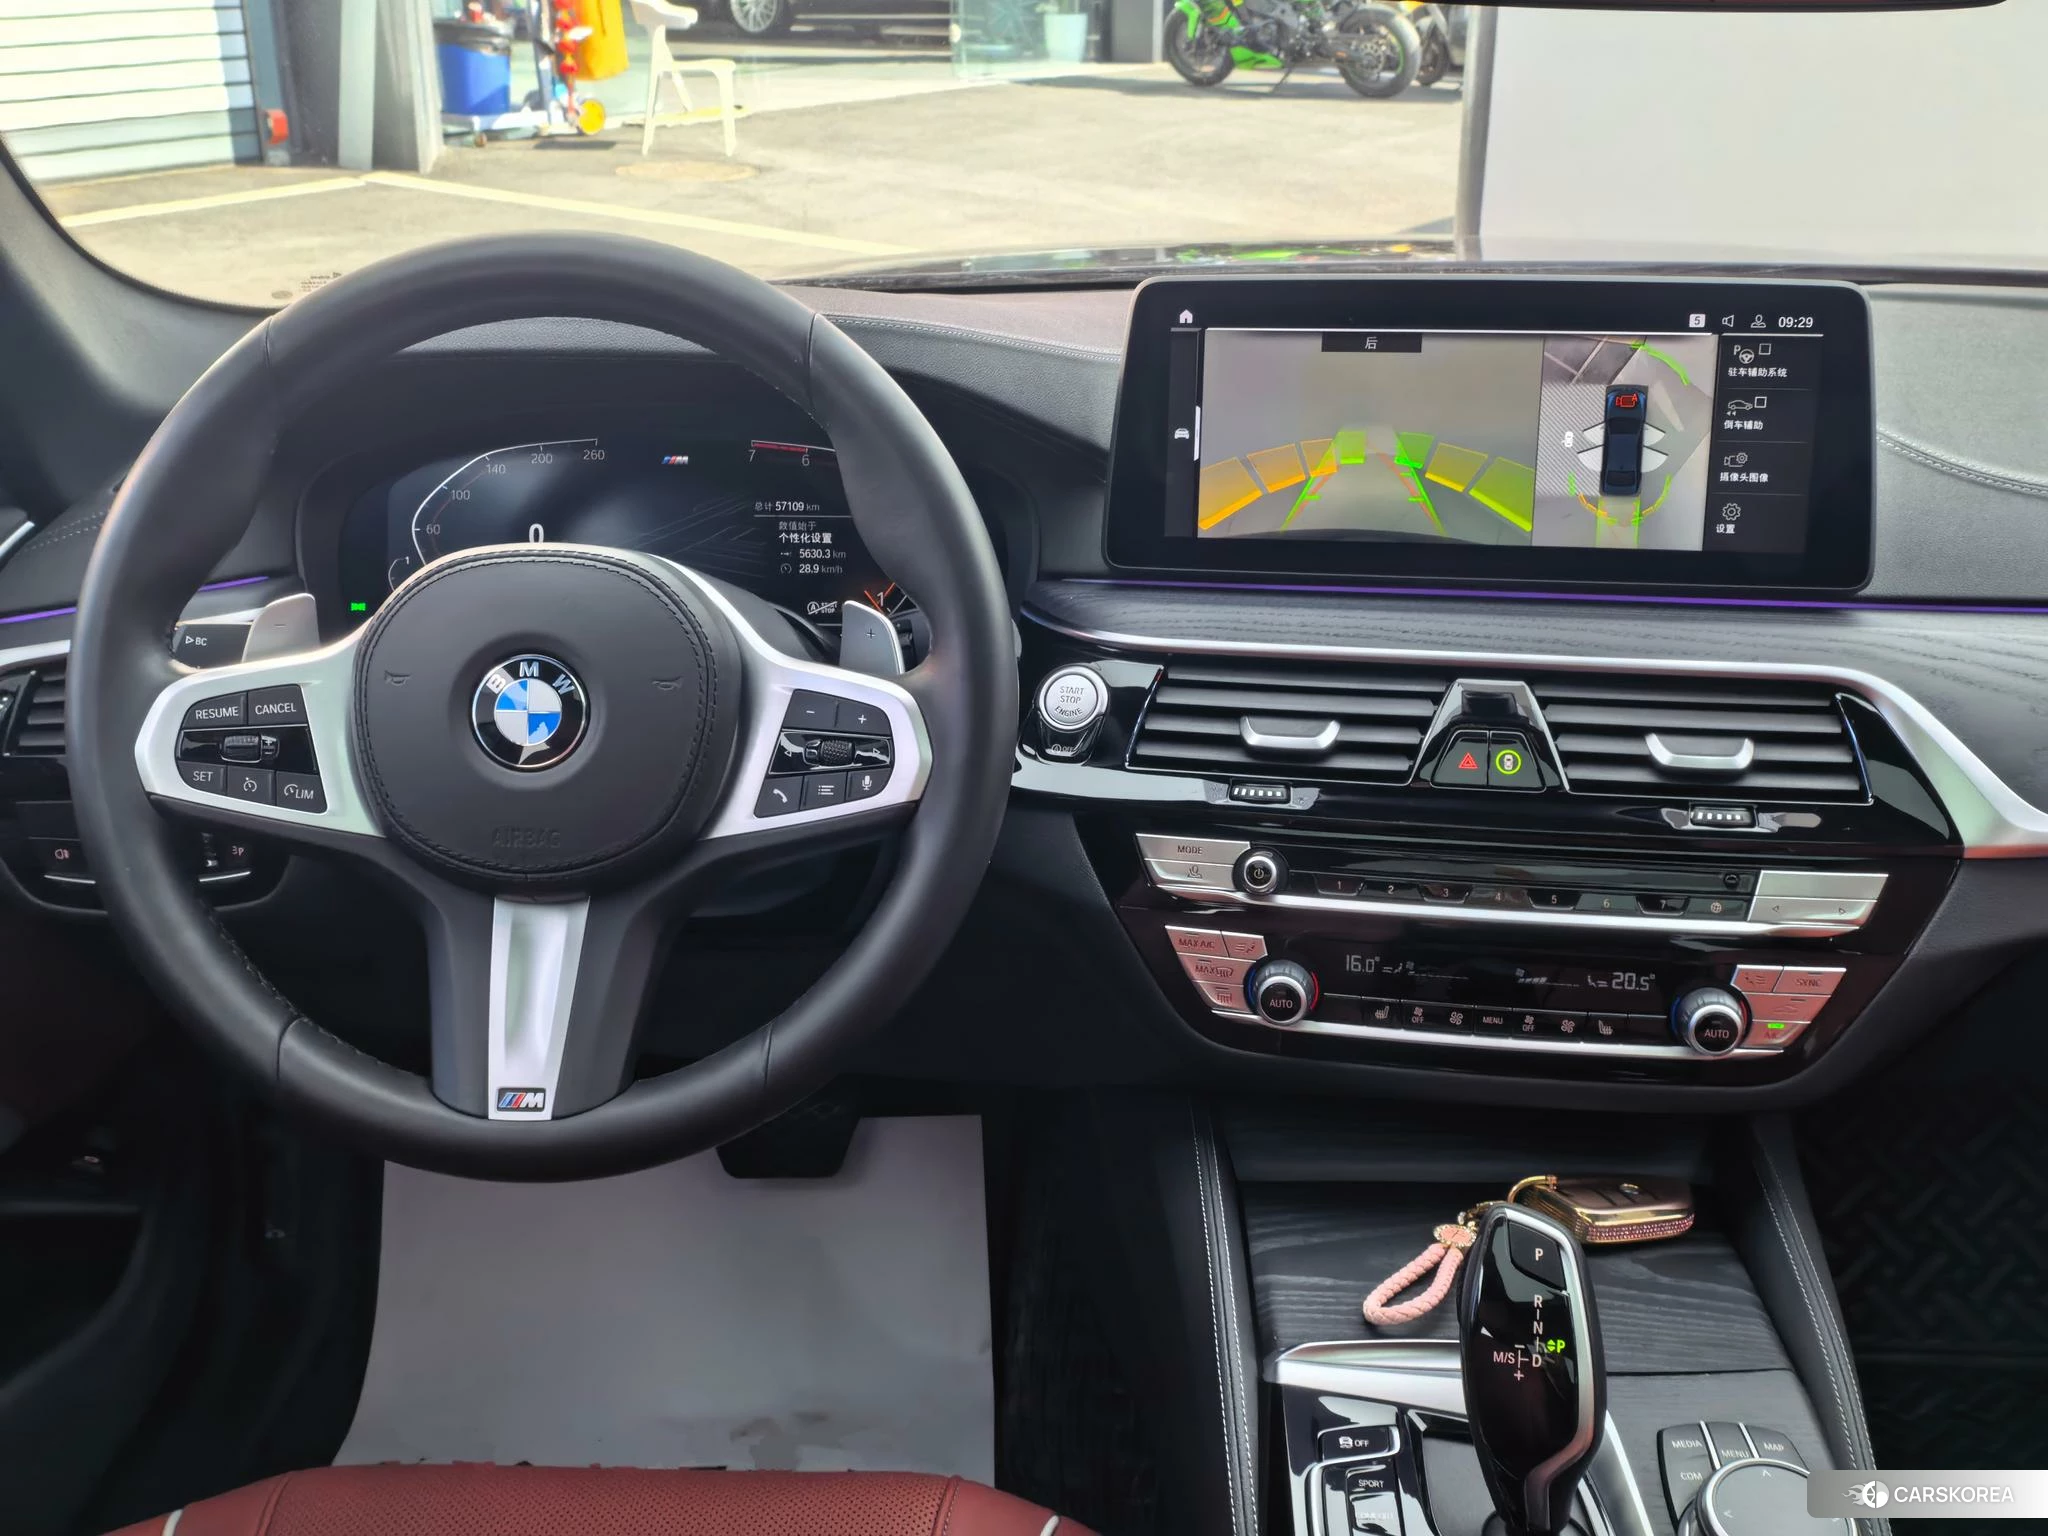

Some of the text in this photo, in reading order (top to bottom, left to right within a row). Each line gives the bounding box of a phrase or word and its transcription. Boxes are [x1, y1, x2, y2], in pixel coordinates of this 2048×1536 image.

[1778, 316, 1814, 328] 09:29
[1365, 336, 1378, 350] 后
[1728, 367, 1788, 378] 驻车辅助系统
[1723, 419, 1764, 430] 倒车辅助
[531, 453, 553, 464] 200
[583, 449, 605, 461] 260
[748, 450, 756, 463] 7
[801, 454, 810, 466] 6
[486, 463, 507, 475] 140
[1719, 472, 1769, 483] 摄像头图像
[451, 490, 471, 501] 100
[755, 501, 820, 512] 总计 57109 km
[426, 524, 441, 535] 60
[778, 521, 817, 531] 数值始于
[1715, 523, 1736, 534] 设置
[528, 523, 545, 543] 0
[778, 532, 832, 544] 个性化设置
[799, 548, 847, 559] 5630.3 km
[799, 563, 843, 574] 28.9 km/h
[195, 637, 208, 646] BC
[486, 661, 575, 695] BMW
[1059, 685, 1084, 696] START
[1059, 695, 1081, 704] STOP
[195, 706, 239, 720] RESUME
[254, 702, 297, 715] CANCEL
[1054, 705, 1083, 717] ENGINE
[192, 771, 214, 782] SET
[295, 789, 314, 799] LIM
[1177, 845, 1204, 855] MODE
[1336, 880, 1343, 890] 1
[1388, 885, 1394, 895] 2
[1443, 888, 1449, 898] 3
[1551, 894, 1558, 904] 5
[1603, 898, 1611, 909] 6
[1178, 937, 1215, 949] MAX A/C
[1195, 965, 1215, 976] MAX
[1796, 978, 1822, 988] SYNC
[1269, 999, 1293, 1009] AUTO
[1411, 1016, 1424, 1024] OFF
[1482, 1016, 1504, 1025] MENU
[1522, 1024, 1535, 1032] OFF
[1704, 1029, 1729, 1039] AUTO
[1535, 1248, 1544, 1261] P
[1534, 1294, 1543, 1308] R
[1533, 1321, 1543, 1335] N
[1493, 1351, 1515, 1364] M/S
[1532, 1354, 1542, 1367] D
[1354, 1439, 1369, 1448] OFF
[1671, 1440, 1703, 1449] MEDIA
[1763, 1443, 1784, 1452] MAP
[1721, 1449, 1750, 1458] MENU
[1680, 1471, 1703, 1480] COM
[1358, 1479, 1385, 1488] SPORT
